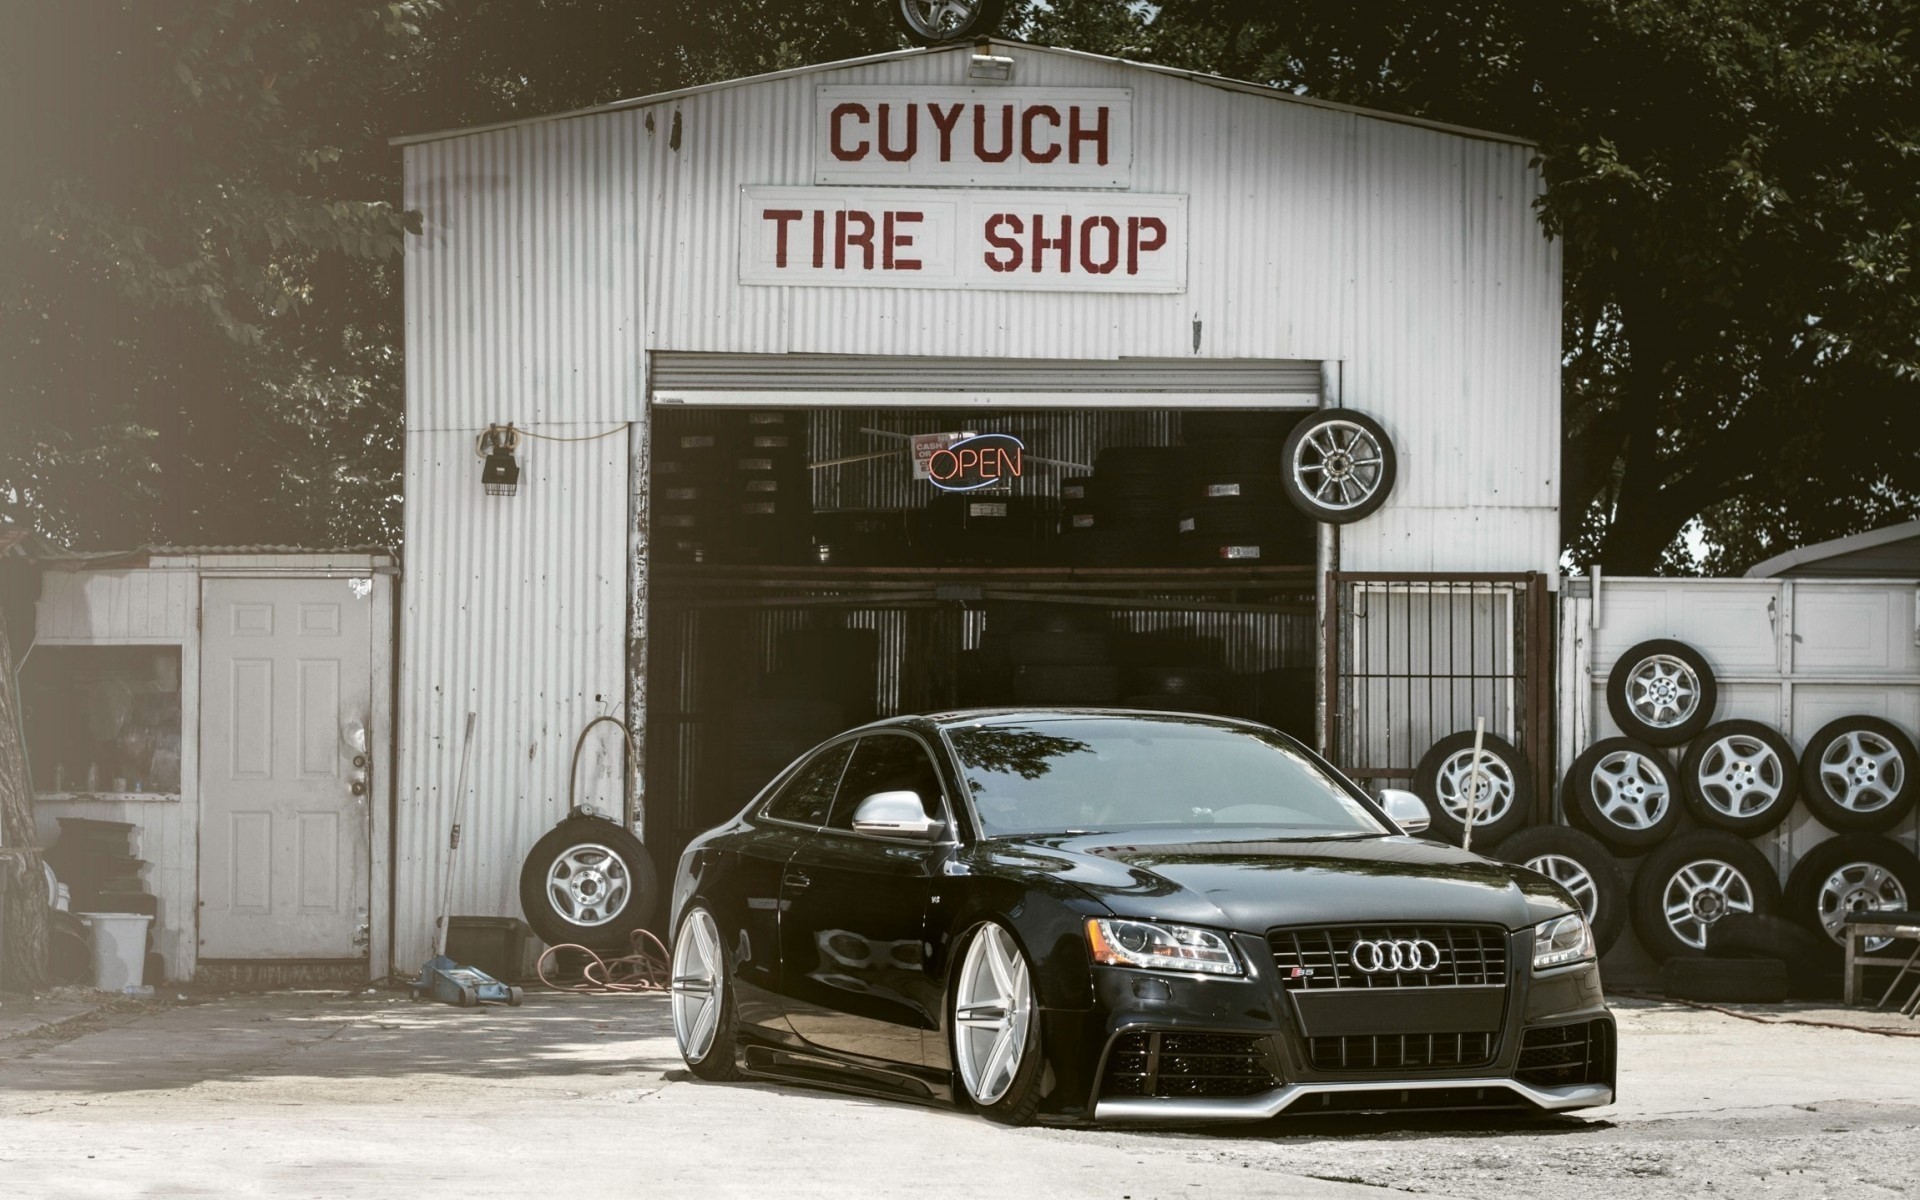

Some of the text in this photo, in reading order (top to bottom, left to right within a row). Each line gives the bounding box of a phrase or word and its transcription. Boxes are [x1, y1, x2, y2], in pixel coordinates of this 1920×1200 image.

[830, 103, 1109, 166] CUYUCH
[763, 209, 1167, 275] TIRE SHOP
[916, 442, 943, 450] CASH
[928, 447, 1021, 480] OPEN
